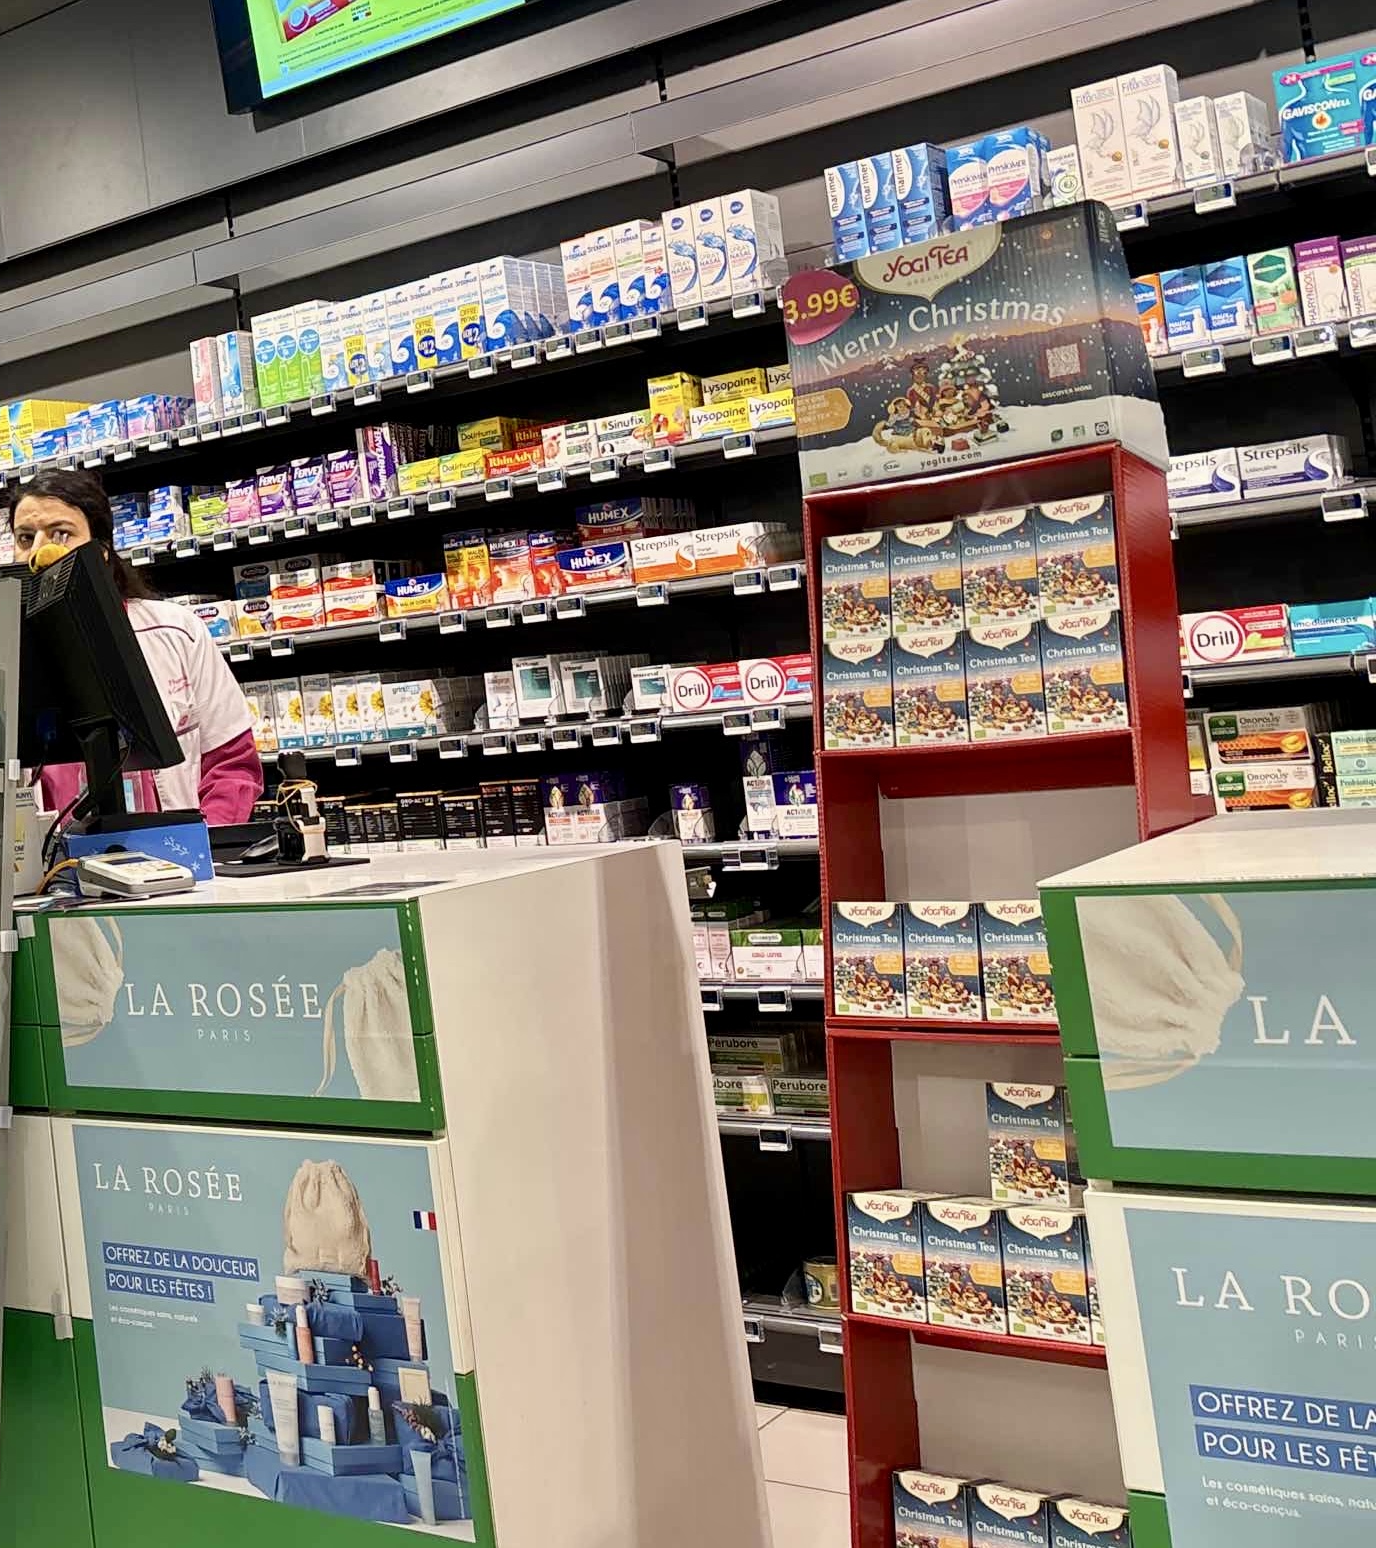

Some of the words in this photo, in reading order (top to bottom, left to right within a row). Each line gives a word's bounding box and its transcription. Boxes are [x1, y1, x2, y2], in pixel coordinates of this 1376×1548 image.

[883, 252, 930, 283] YOGI
[928, 245, 969, 265] TEA
[784, 283, 858, 324] 3.99€
[816, 319, 899, 374] Merry
[908, 299, 1065, 333] Christmas
[704, 375, 757, 394] Lysopaine
[608, 416, 644, 431] Sinufix
[692, 406, 746, 424] Lysopaine
[920, 450, 982, 468] yogitea.com
[1244, 442, 1309, 461] Strepsils
[294, 465, 323, 480] FERVEX
[588, 508, 630, 524] HUMEX
[695, 528, 741, 544] Strepsils
[1039, 528, 1088, 543] Christmas
[1091, 526, 1109, 536] Tea
[635, 538, 680, 553] Strepsils
[965, 542, 1012, 556] Christmas
[1014, 540, 1030, 550] Tea
[570, 553, 612, 569] HUMEX
[826, 561, 868, 574] Christmas
[870, 560, 885, 570] Tea
[894, 553, 938, 566] Christmas
[940, 551, 956, 562] Tea
[397, 583, 430, 596] HUMEX
[1197, 631, 1235, 648] Drill
[1046, 645, 1096, 660] Christmas
[1099, 643, 1117, 654] Tea
[896, 663, 941, 676] Christmas
[943, 661, 960, 672] Tea
[970, 655, 1017, 669] Christmas
[1019, 654, 1036, 664] Tea
[750, 675, 778, 690] Drill
[827, 670, 870, 682] Christmas
[872, 668, 888, 678] Tea
[678, 683, 705, 697] Drill
[837, 932, 880, 944] Christmas
[882, 934, 898, 944] Tea
[908, 933, 954, 945] Christmas
[957, 934, 973, 945] Tea
[984, 932, 1033, 944] Christmas
[125, 982, 173, 1016] LA
[188, 975, 322, 1019] ROSÉE
[1247, 995, 1357, 1045] LA
[198, 1029, 251, 1043] PARIS
[712, 1079, 743, 1090] ubore
[773, 1080, 827, 1093] Perubore
[991, 1113, 1039, 1127] Christmas
[1042, 1117, 1059, 1128] Tea
[93, 1162, 131, 1192] LA
[141, 1165, 243, 1201] ROSÉE
[852, 1226, 899, 1241] Christmas
[901, 1231, 916, 1243] Tea
[927, 1236, 976, 1251] Christmas
[978, 1242, 995, 1253] Tea
[1007, 1243, 1057, 1259] Christmas
[1059, 1249, 1078, 1261] Tea
[105, 1246, 149, 1264] OFFREZ
[154, 1252, 170, 1267] DE
[174, 1254, 190, 1269] LA
[193, 1256, 256, 1278] DOUCEUR
[109, 1274, 142, 1291] POUR
[145, 1278, 166, 1294] LES
[169, 1280, 205, 1299] FÊTES
[207, 1286, 211, 1299] !
[1171, 1267, 1254, 1311] LA
[1280, 1275, 1371, 1320] RO
[1198, 1391, 1298, 1422] OFFREZ
[1305, 1403, 1340, 1426] DE
[1203, 1432, 1276, 1460] POUR
[1285, 1443, 1330, 1467] LES
[1202, 1476, 1222, 1489] Les
[1225, 1480, 1304, 1501] cosmétiques
[1309, 1492, 1344, 1506] sains,
[1206, 1495, 1220, 1506] et
[1223, 1497, 1302, 1518] éco-conçus.
[898, 1507, 945, 1525] Christmas
[947, 1516, 962, 1528] Tea
[976, 1521, 1025, 1539] Christmas
[1026, 1531, 1044, 1544] Tea
